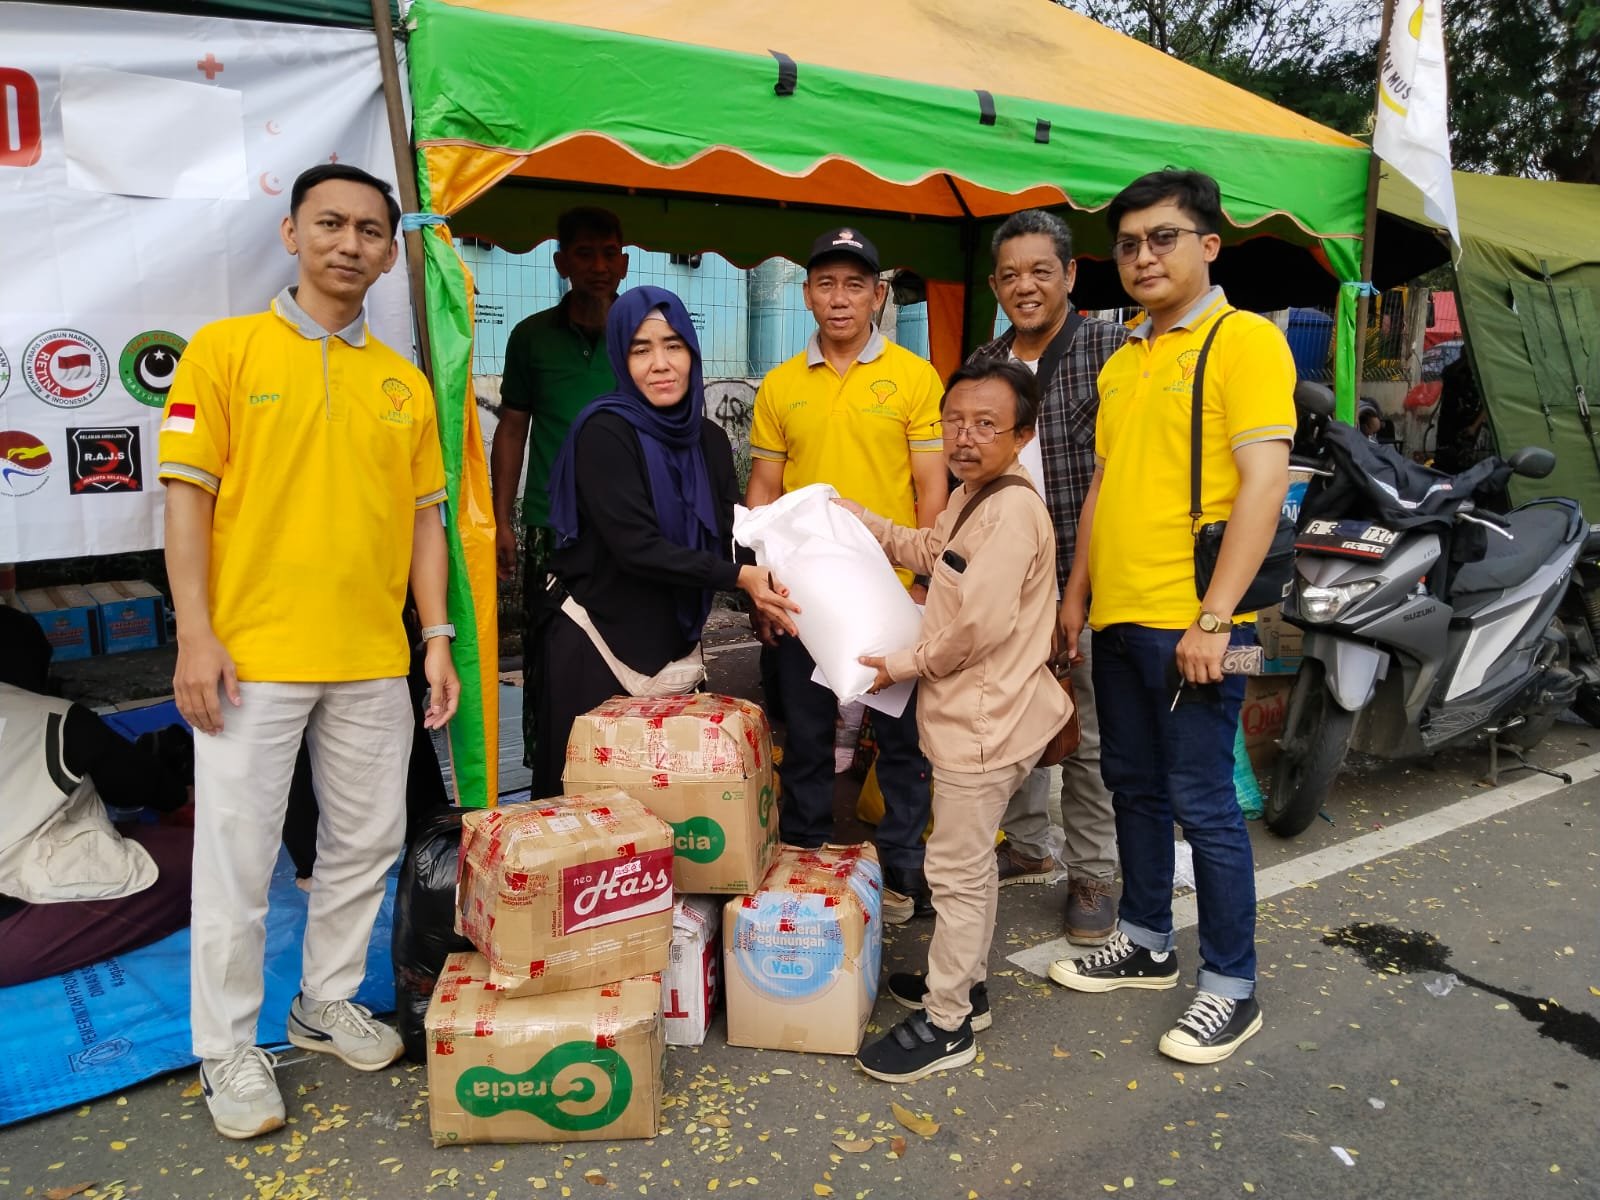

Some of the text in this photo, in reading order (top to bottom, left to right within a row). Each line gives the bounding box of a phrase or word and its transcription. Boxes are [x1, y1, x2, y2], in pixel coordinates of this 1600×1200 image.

[35, 351, 61, 396] RETINA
[52, 396, 89, 405] INDONESIA
[84, 452, 125, 461] R.A.J.S
[1402, 605, 1436, 622] SUZUKI
[675, 831, 711, 850] cia
[574, 875, 592, 886] neo
[574, 869, 668, 916] Hass
[750, 932, 826, 948] Pegunungan
[771, 960, 804, 975] Vale
[69, 995, 97, 1045] PEMERINTAH
